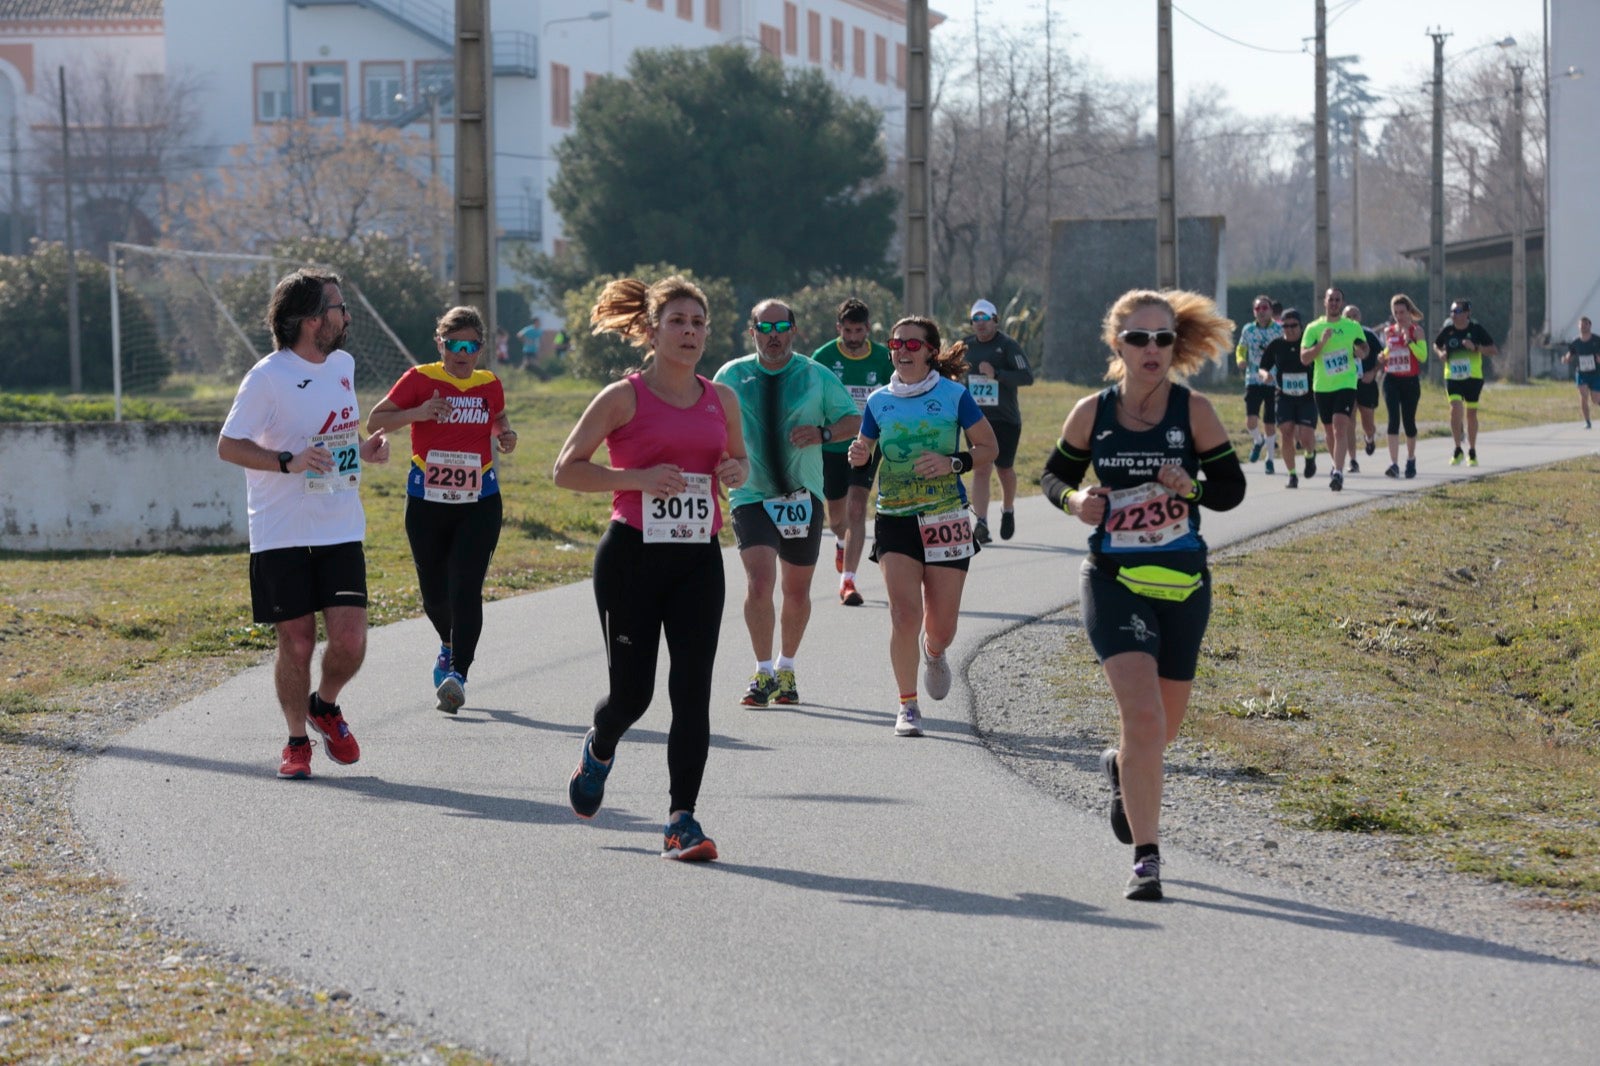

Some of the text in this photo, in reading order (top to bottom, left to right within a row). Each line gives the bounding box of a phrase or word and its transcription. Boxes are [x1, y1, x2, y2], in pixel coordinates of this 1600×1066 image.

[973, 384, 993, 395] 272
[1098, 457, 1134, 467] PAZITO
[1128, 468, 1153, 476] Motril
[427, 466, 477, 488] 2291
[652, 496, 709, 520] 3015
[773, 504, 807, 523] 760
[1111, 497, 1184, 531] 2236
[924, 521, 971, 545] 2033
